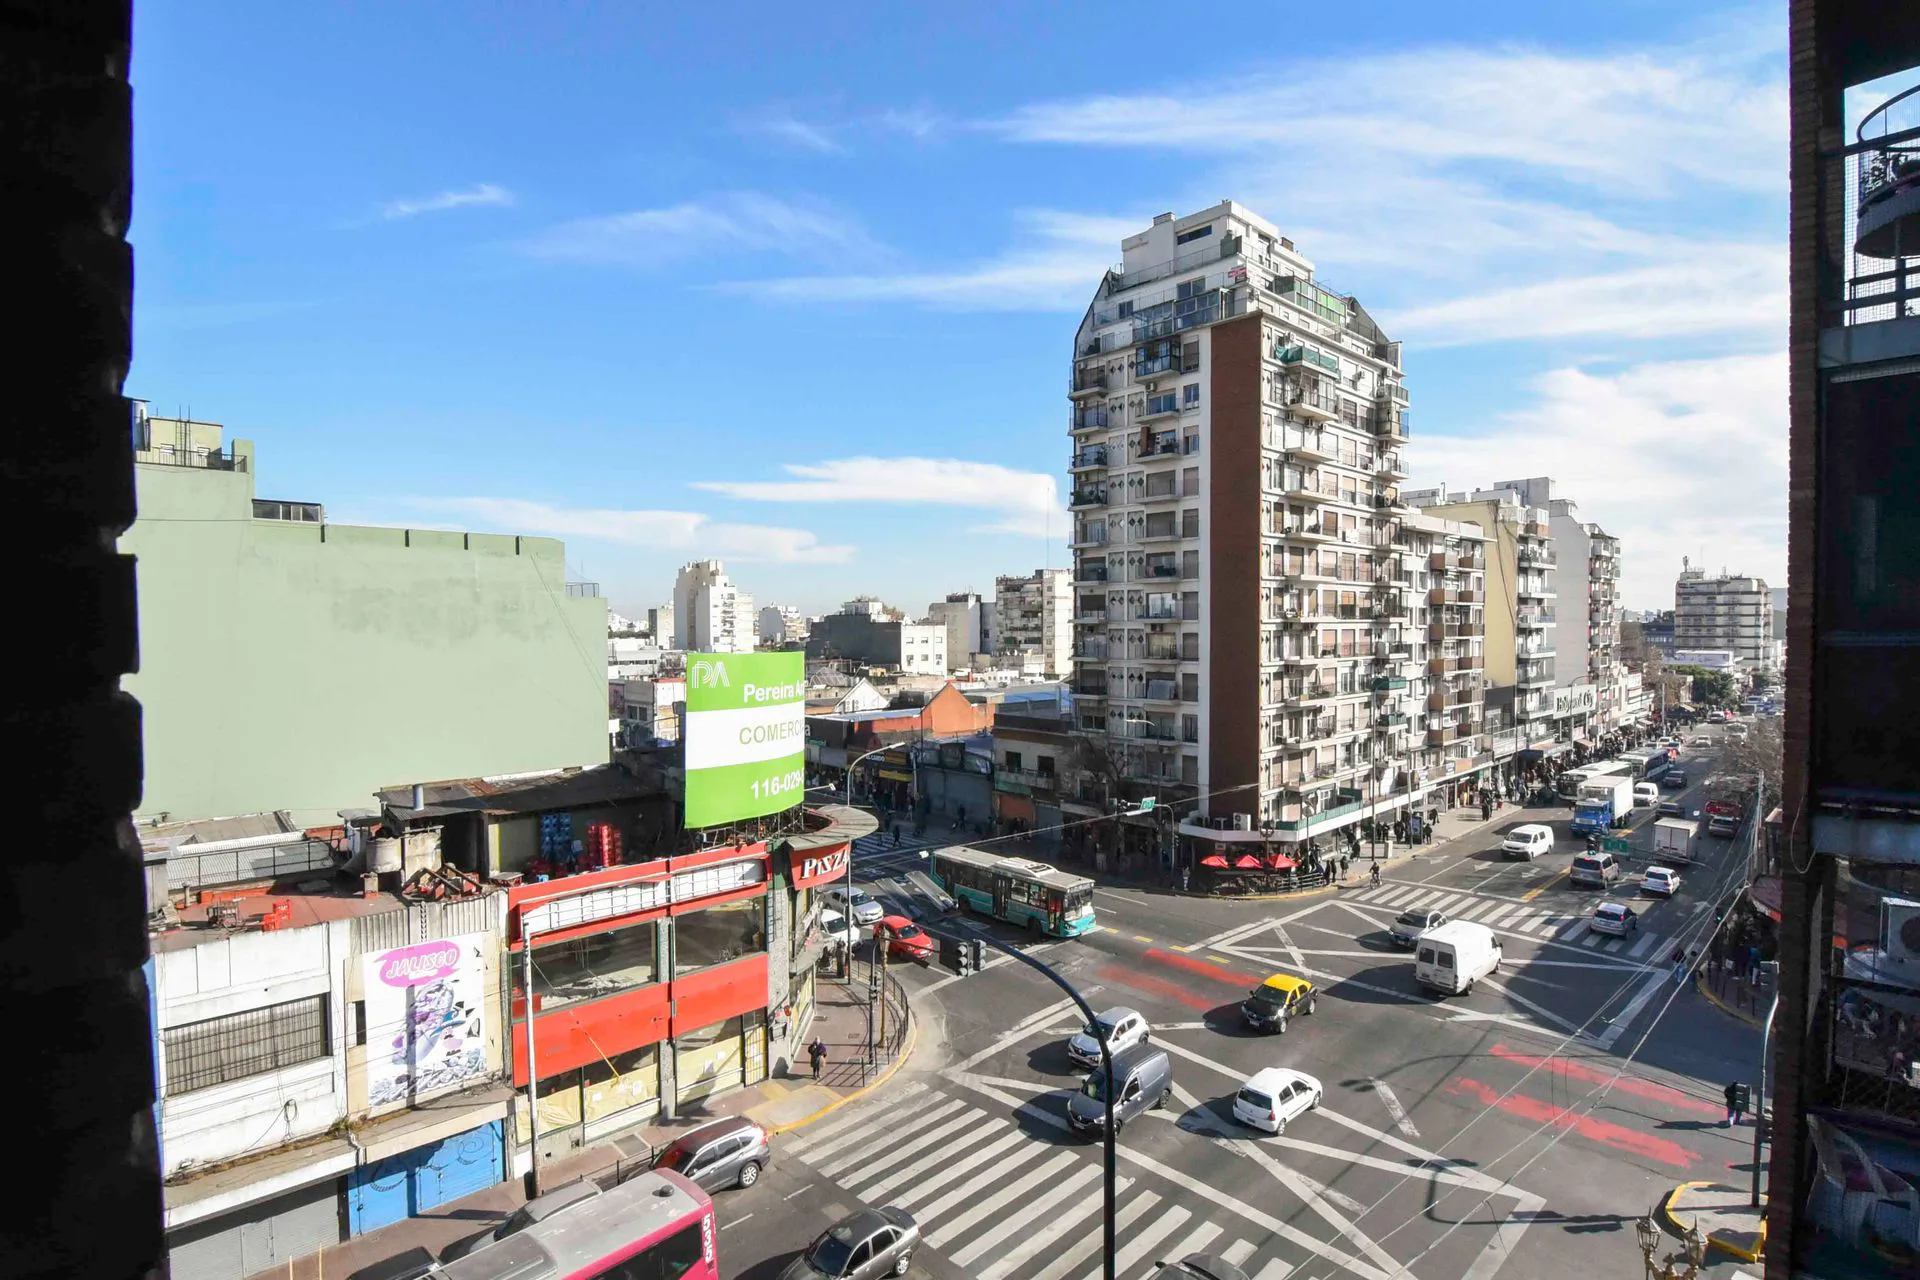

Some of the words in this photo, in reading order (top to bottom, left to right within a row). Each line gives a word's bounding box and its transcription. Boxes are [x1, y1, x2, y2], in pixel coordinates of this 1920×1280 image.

[743, 681, 794, 704] Pereira
[386, 949, 457, 979] JALISCO
[703, 1213, 713, 1264] 535
